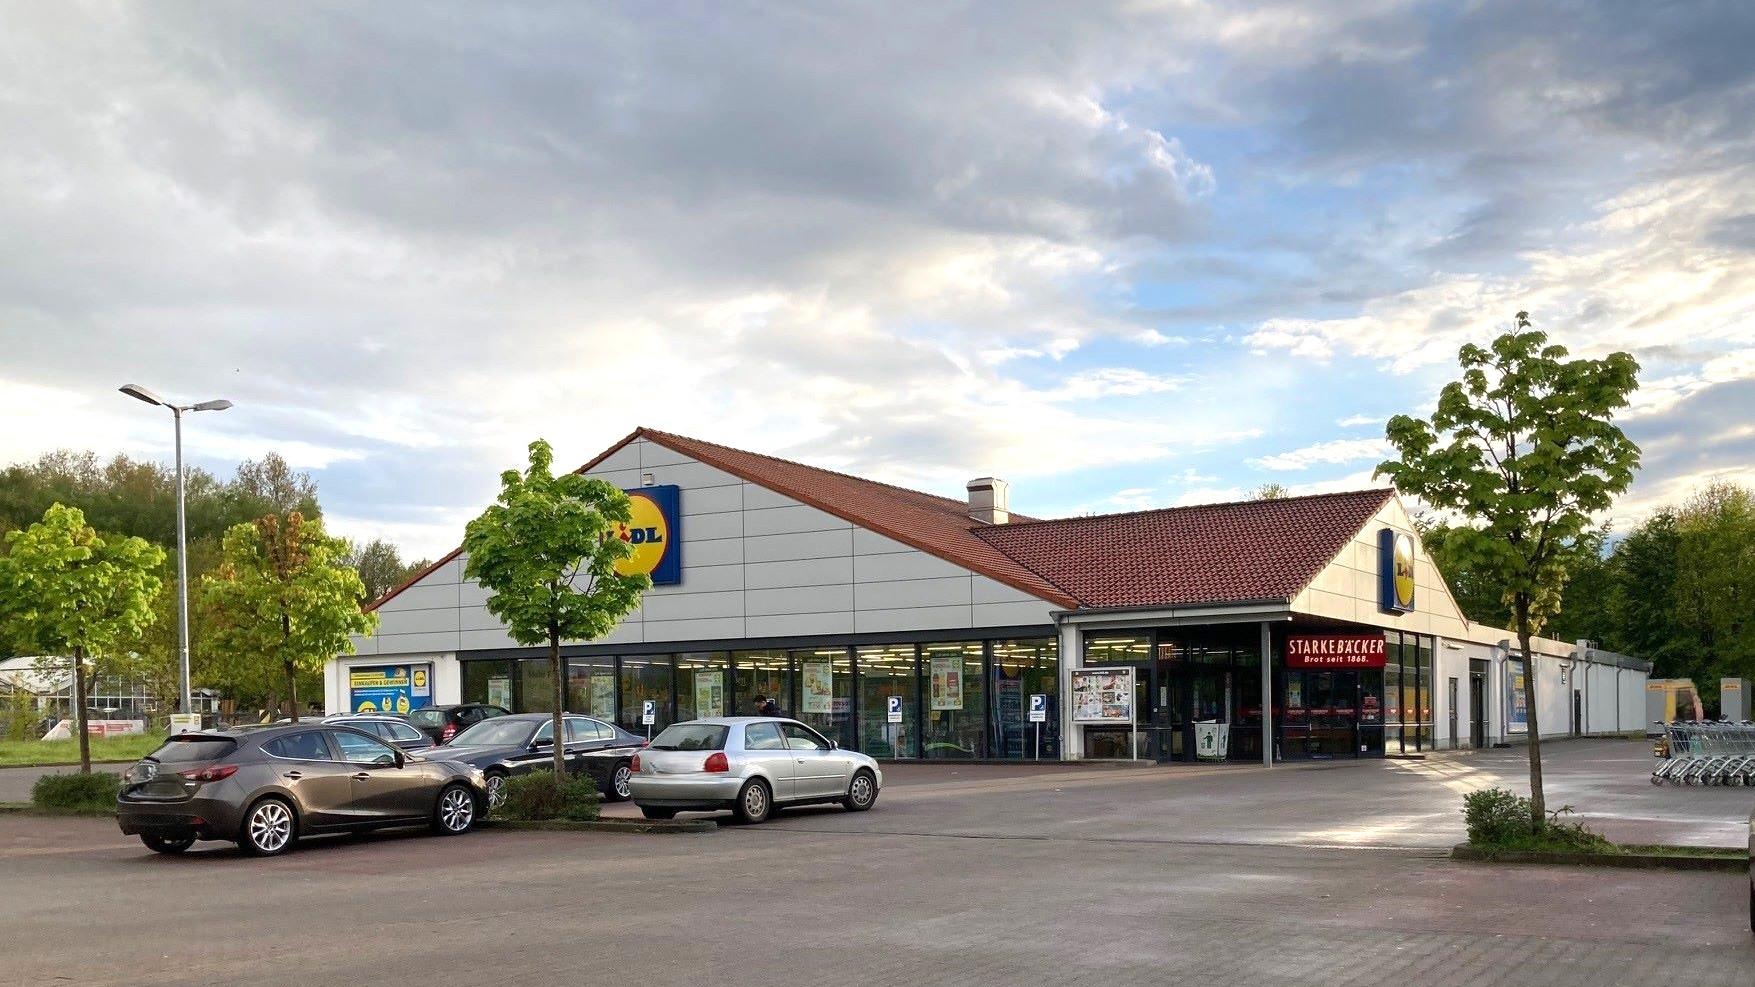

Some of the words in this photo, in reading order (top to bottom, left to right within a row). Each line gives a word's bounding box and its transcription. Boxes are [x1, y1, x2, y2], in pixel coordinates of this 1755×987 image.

[606, 523, 663, 545] IDL
[1304, 655, 1323, 663] Brot
[1326, 655, 1344, 663] seit
[1347, 655, 1369, 663] 1868.
[644, 702, 653, 715] P
[890, 698, 899, 712] P
[1031, 696, 1042, 711] P
